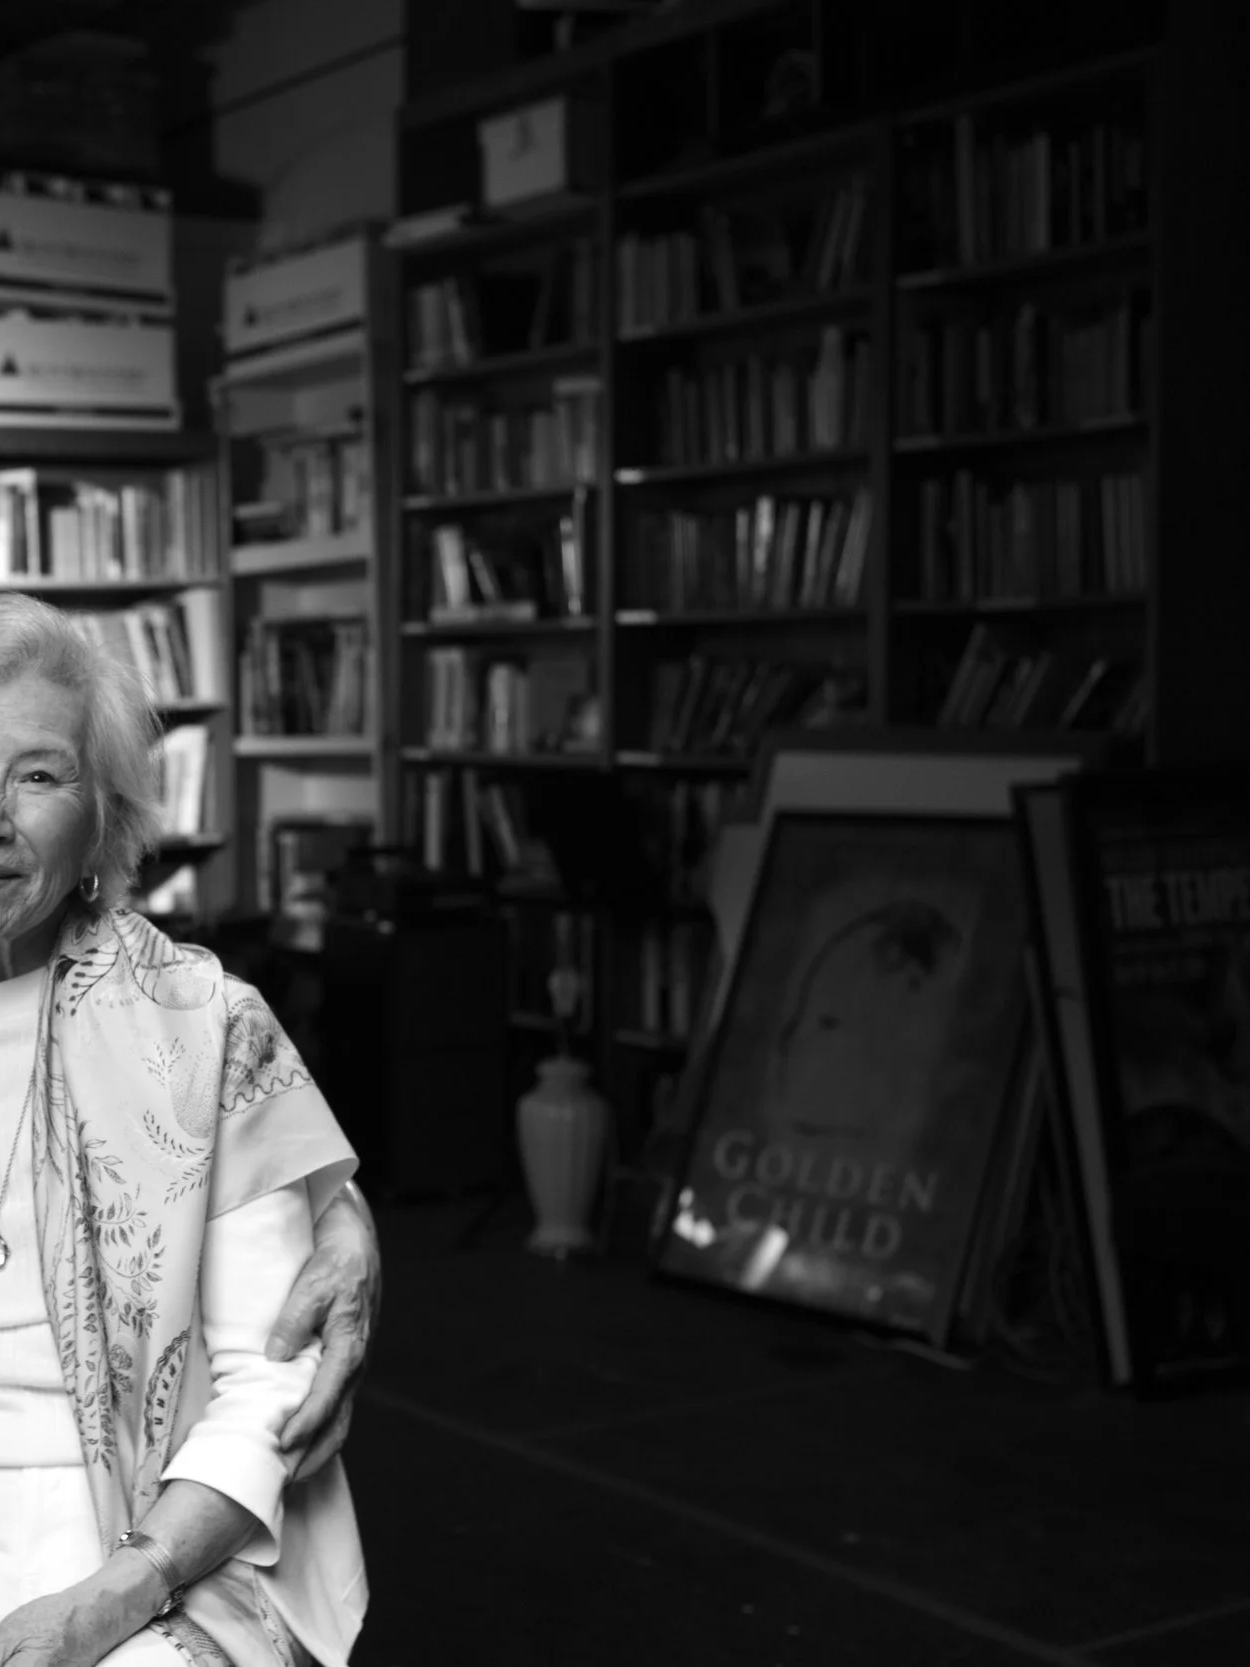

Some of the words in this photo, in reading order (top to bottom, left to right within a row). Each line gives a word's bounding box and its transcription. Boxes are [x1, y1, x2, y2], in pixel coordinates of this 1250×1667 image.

[1104, 874, 1164, 931] THE
[713, 1130, 940, 1212] GOLDEN
[726, 1182, 901, 1259] CHILD
